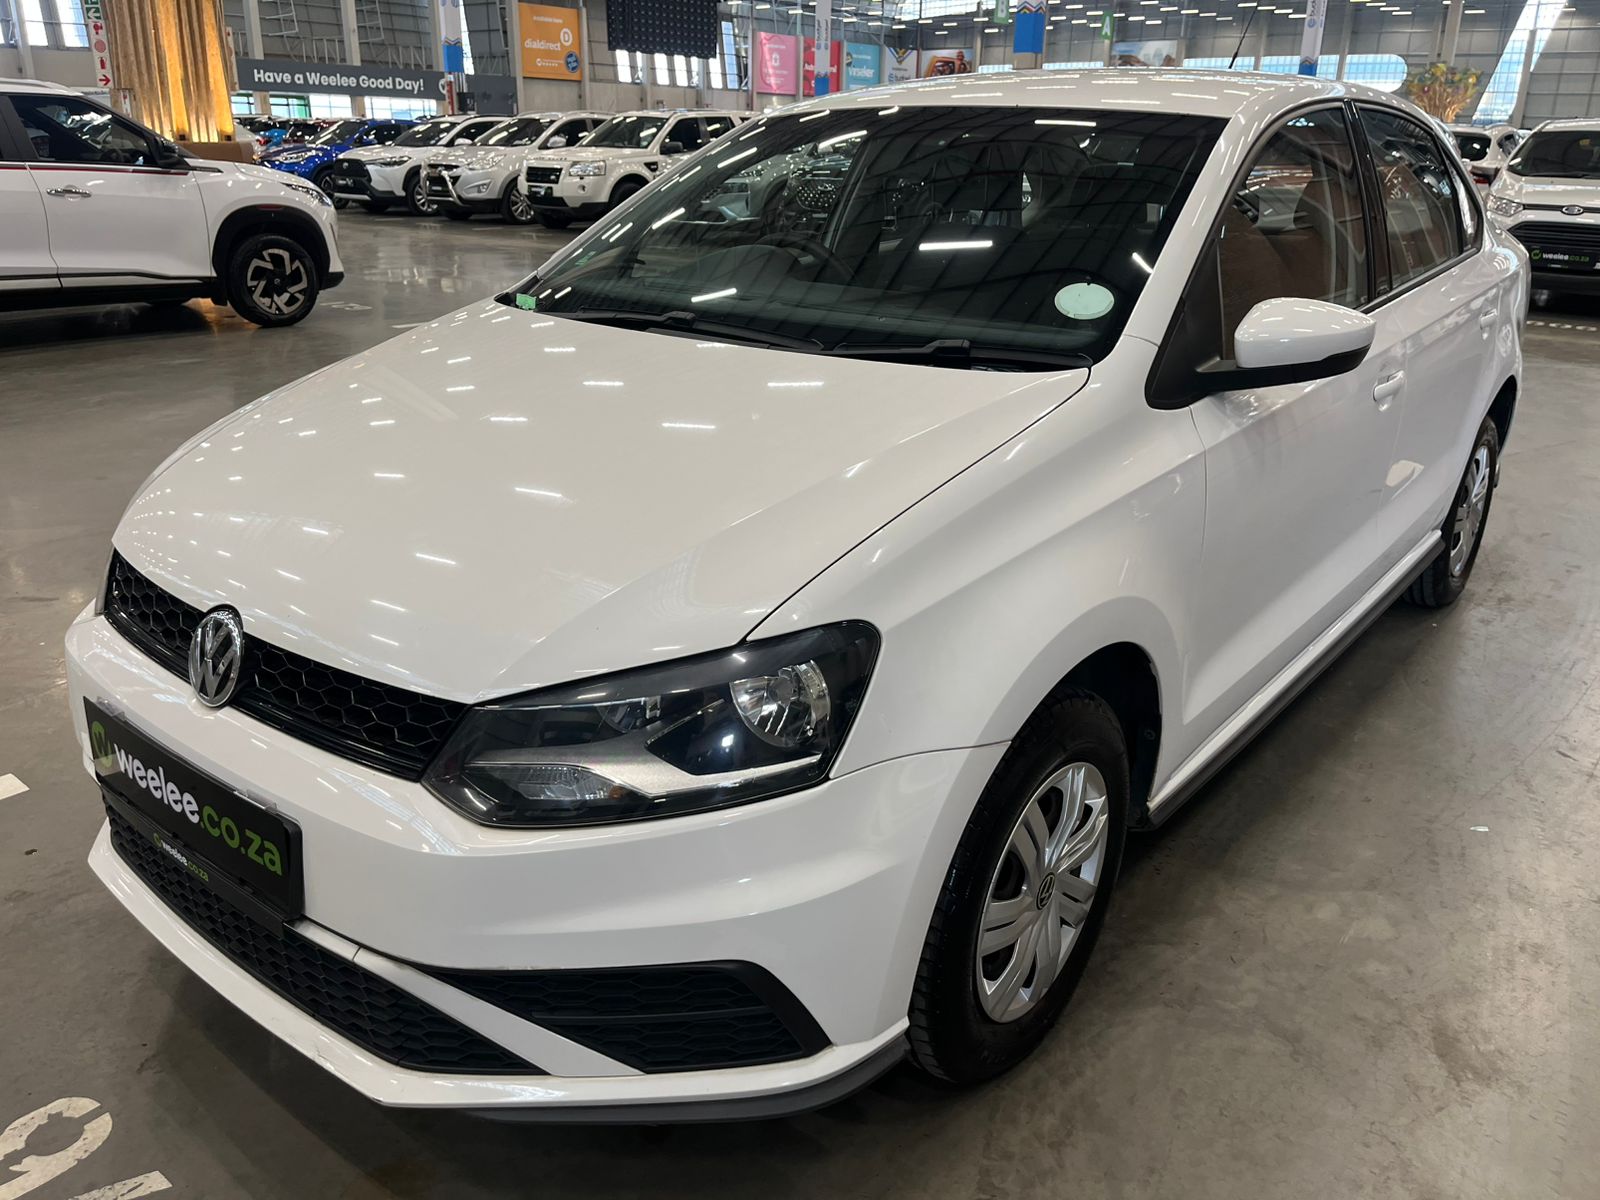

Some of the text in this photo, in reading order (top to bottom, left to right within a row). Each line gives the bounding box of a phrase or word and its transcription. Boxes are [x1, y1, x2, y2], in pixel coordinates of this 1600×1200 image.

[1102, 15, 1111, 36] A
[524, 38, 561, 51] dialdirect
[253, 69, 291, 84] Have
[294, 74, 304, 85] a
[306, 72, 357, 87] Weelee
[359, 75, 393, 89] Good
[395, 77, 424, 94] Day!
[113, 743, 283, 876] weelee.co.za
[161, 839, 209, 882] weelee.co.za
